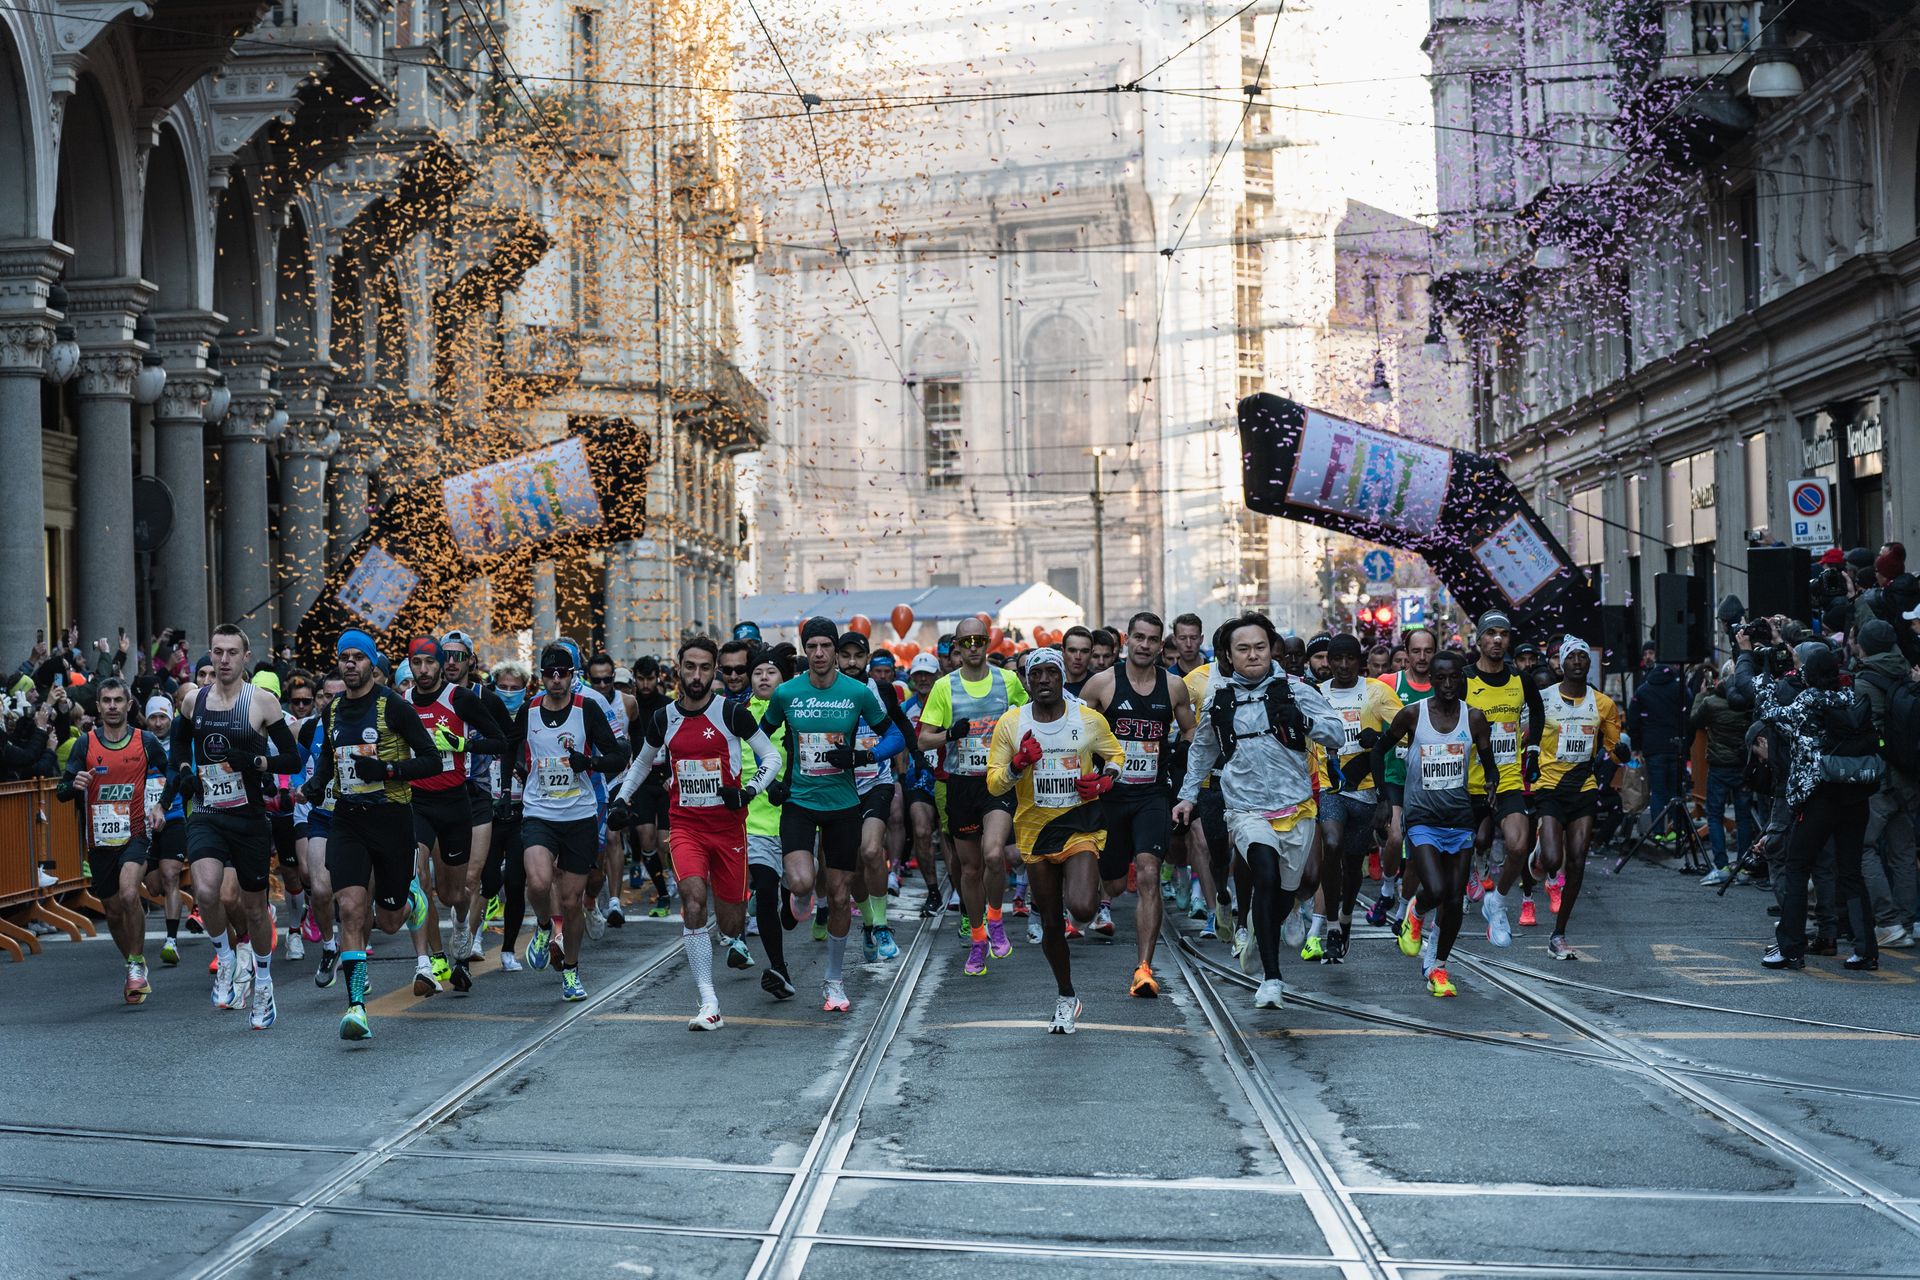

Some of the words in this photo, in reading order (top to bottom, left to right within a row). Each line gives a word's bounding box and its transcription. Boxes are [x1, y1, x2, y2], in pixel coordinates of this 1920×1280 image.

[1319, 433, 1422, 518] FIAT
[790, 697, 803, 708] La
[806, 697, 855, 709] Recastello
[1566, 740, 1586, 752] NJERI
[969, 755, 987, 765] 134
[1126, 759, 1147, 771] 202
[1423, 761, 1462, 778] KIPROTICH
[549, 774, 569, 787] 222
[680, 778, 720, 794] PERCONTE
[212, 782, 232, 795] 215
[102, 822, 120, 833] 238
